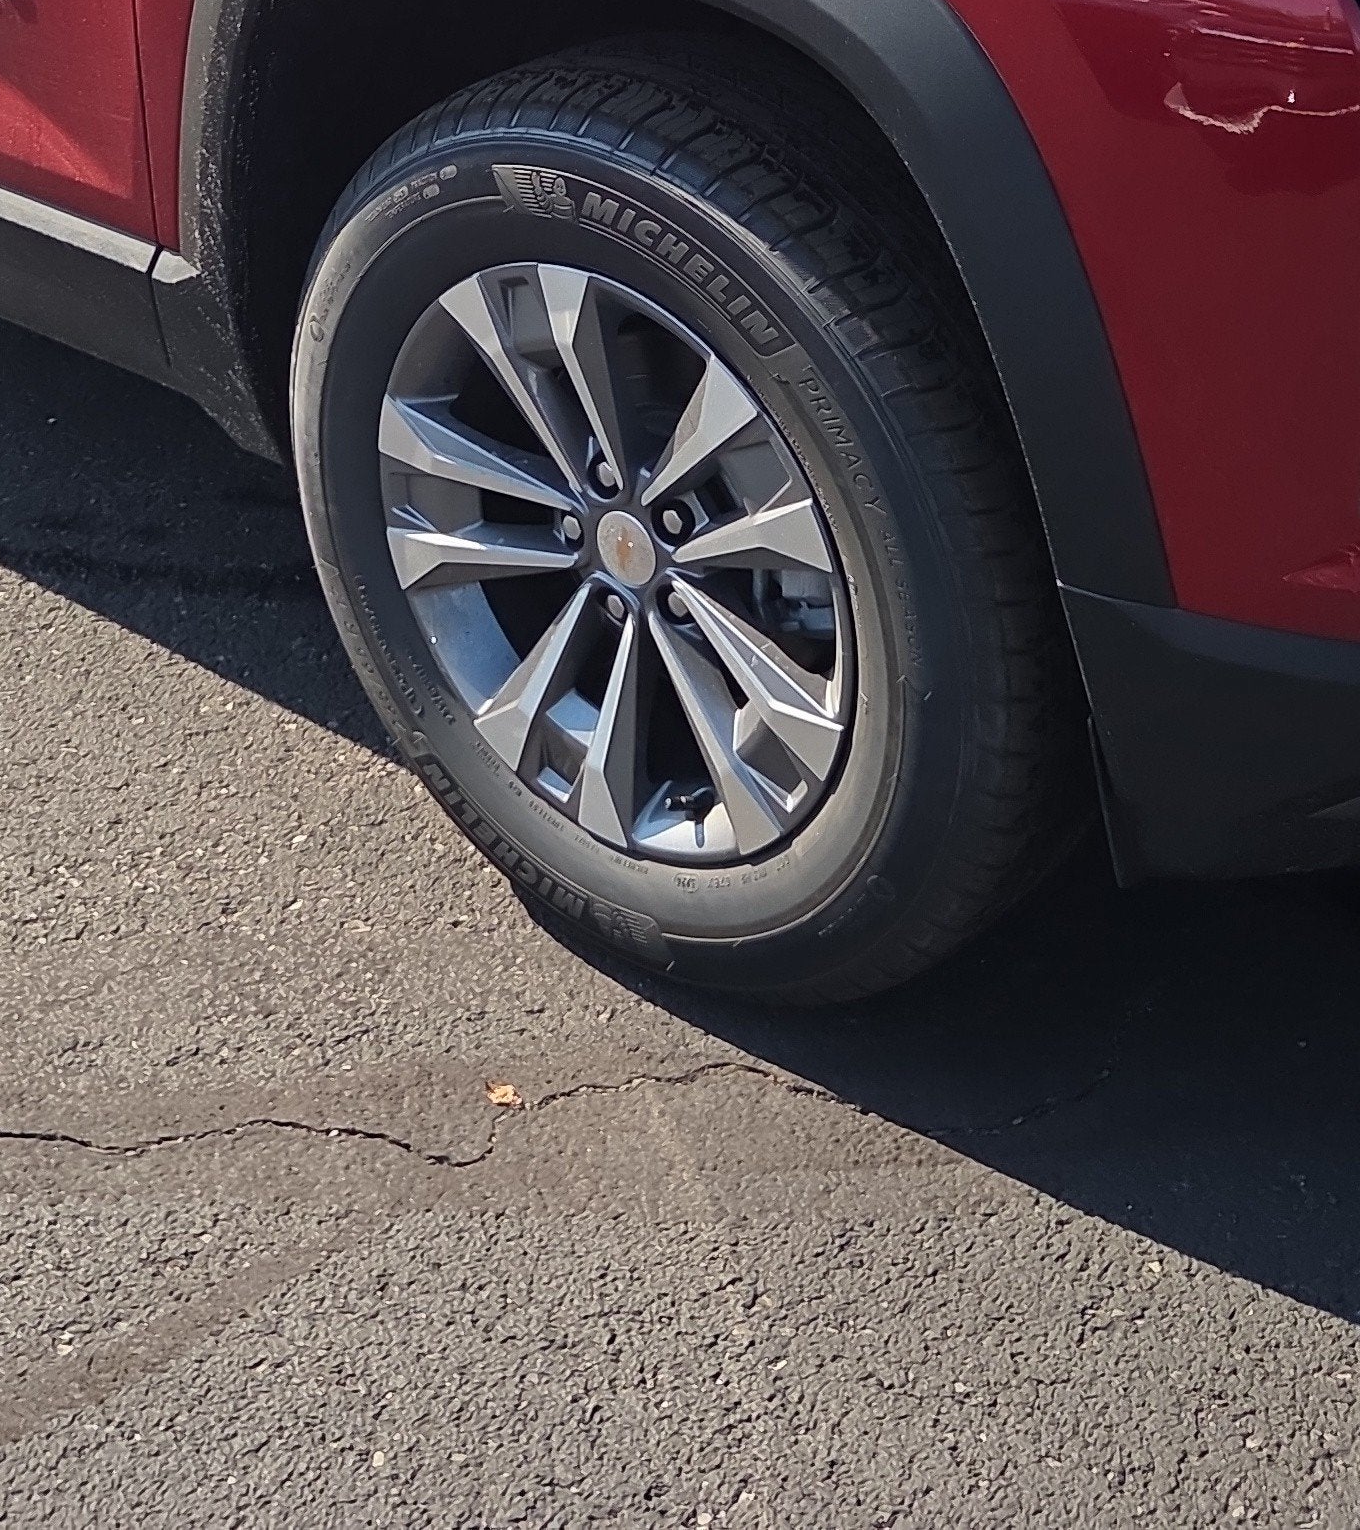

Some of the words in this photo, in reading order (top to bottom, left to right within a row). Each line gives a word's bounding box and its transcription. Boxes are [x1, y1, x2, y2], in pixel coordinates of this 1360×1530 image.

[580, 191, 780, 345] MICHELIN
[798, 378, 887, 515] PRIMACY
[423, 762, 585, 920] MICHELIN
